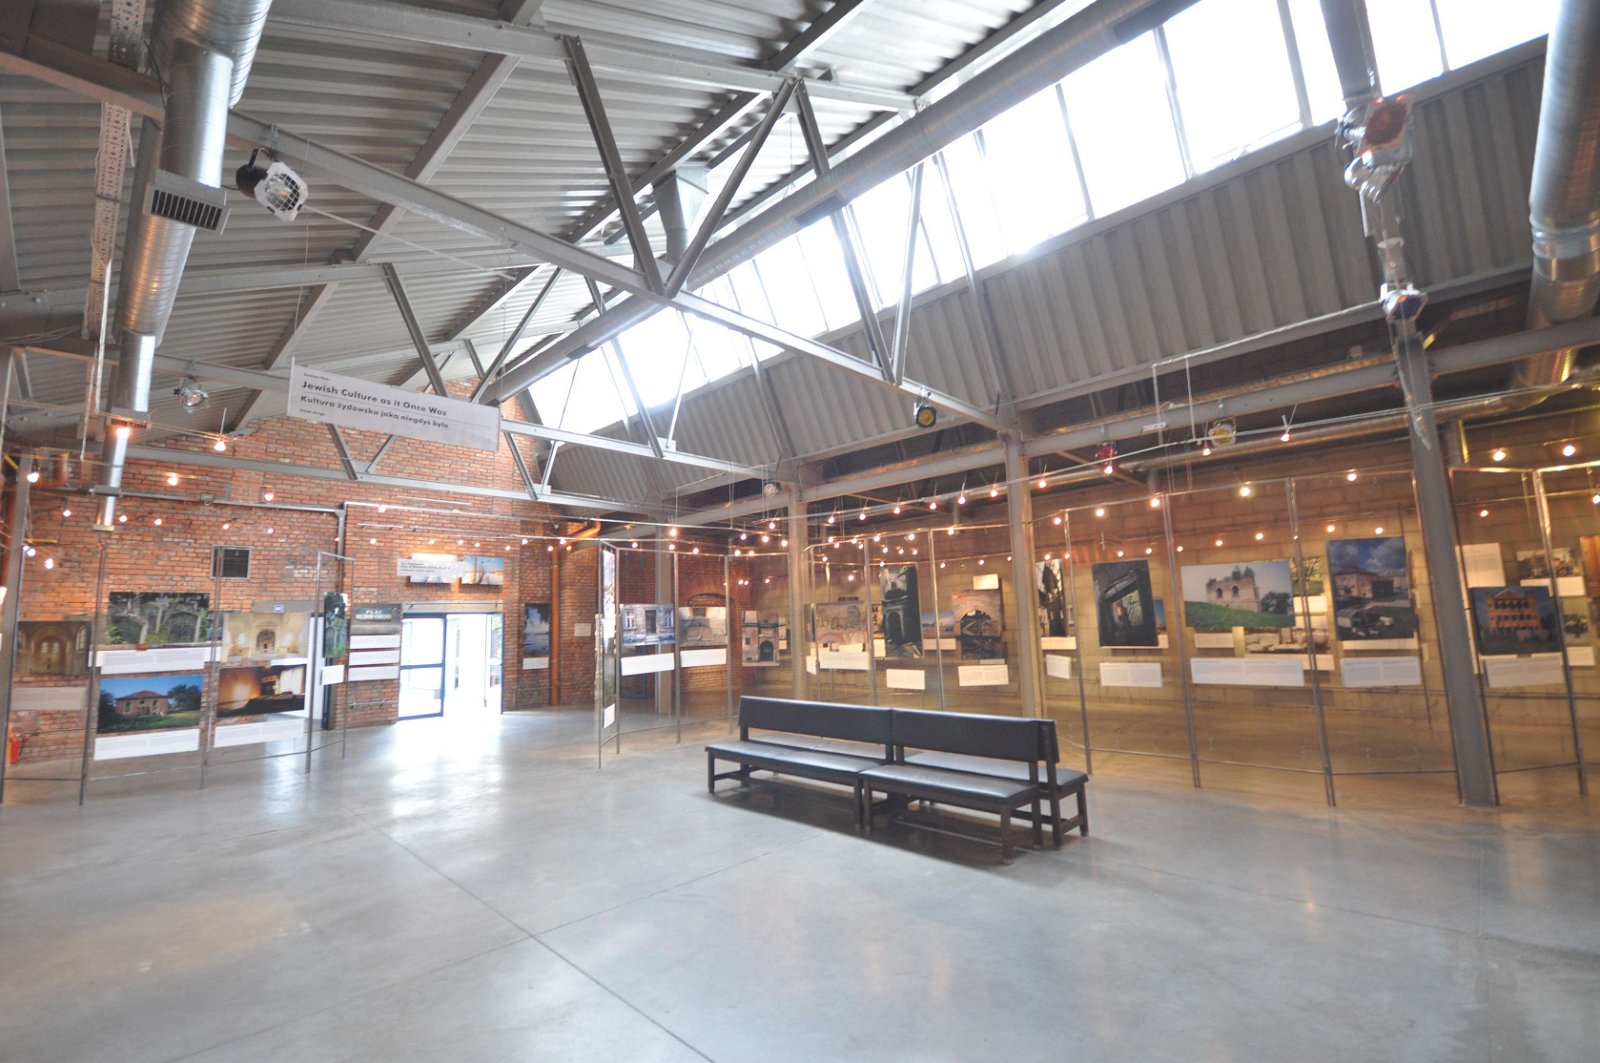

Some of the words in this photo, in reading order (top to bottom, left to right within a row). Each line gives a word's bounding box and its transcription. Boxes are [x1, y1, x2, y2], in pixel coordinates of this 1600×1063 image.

[300, 395, 335, 407] Kultura
[301, 381, 338, 394] Jewish
[341, 389, 378, 402] Culture
[380, 397, 391, 406] as
[403, 401, 426, 411] Once
[428, 406, 447, 416] Was
